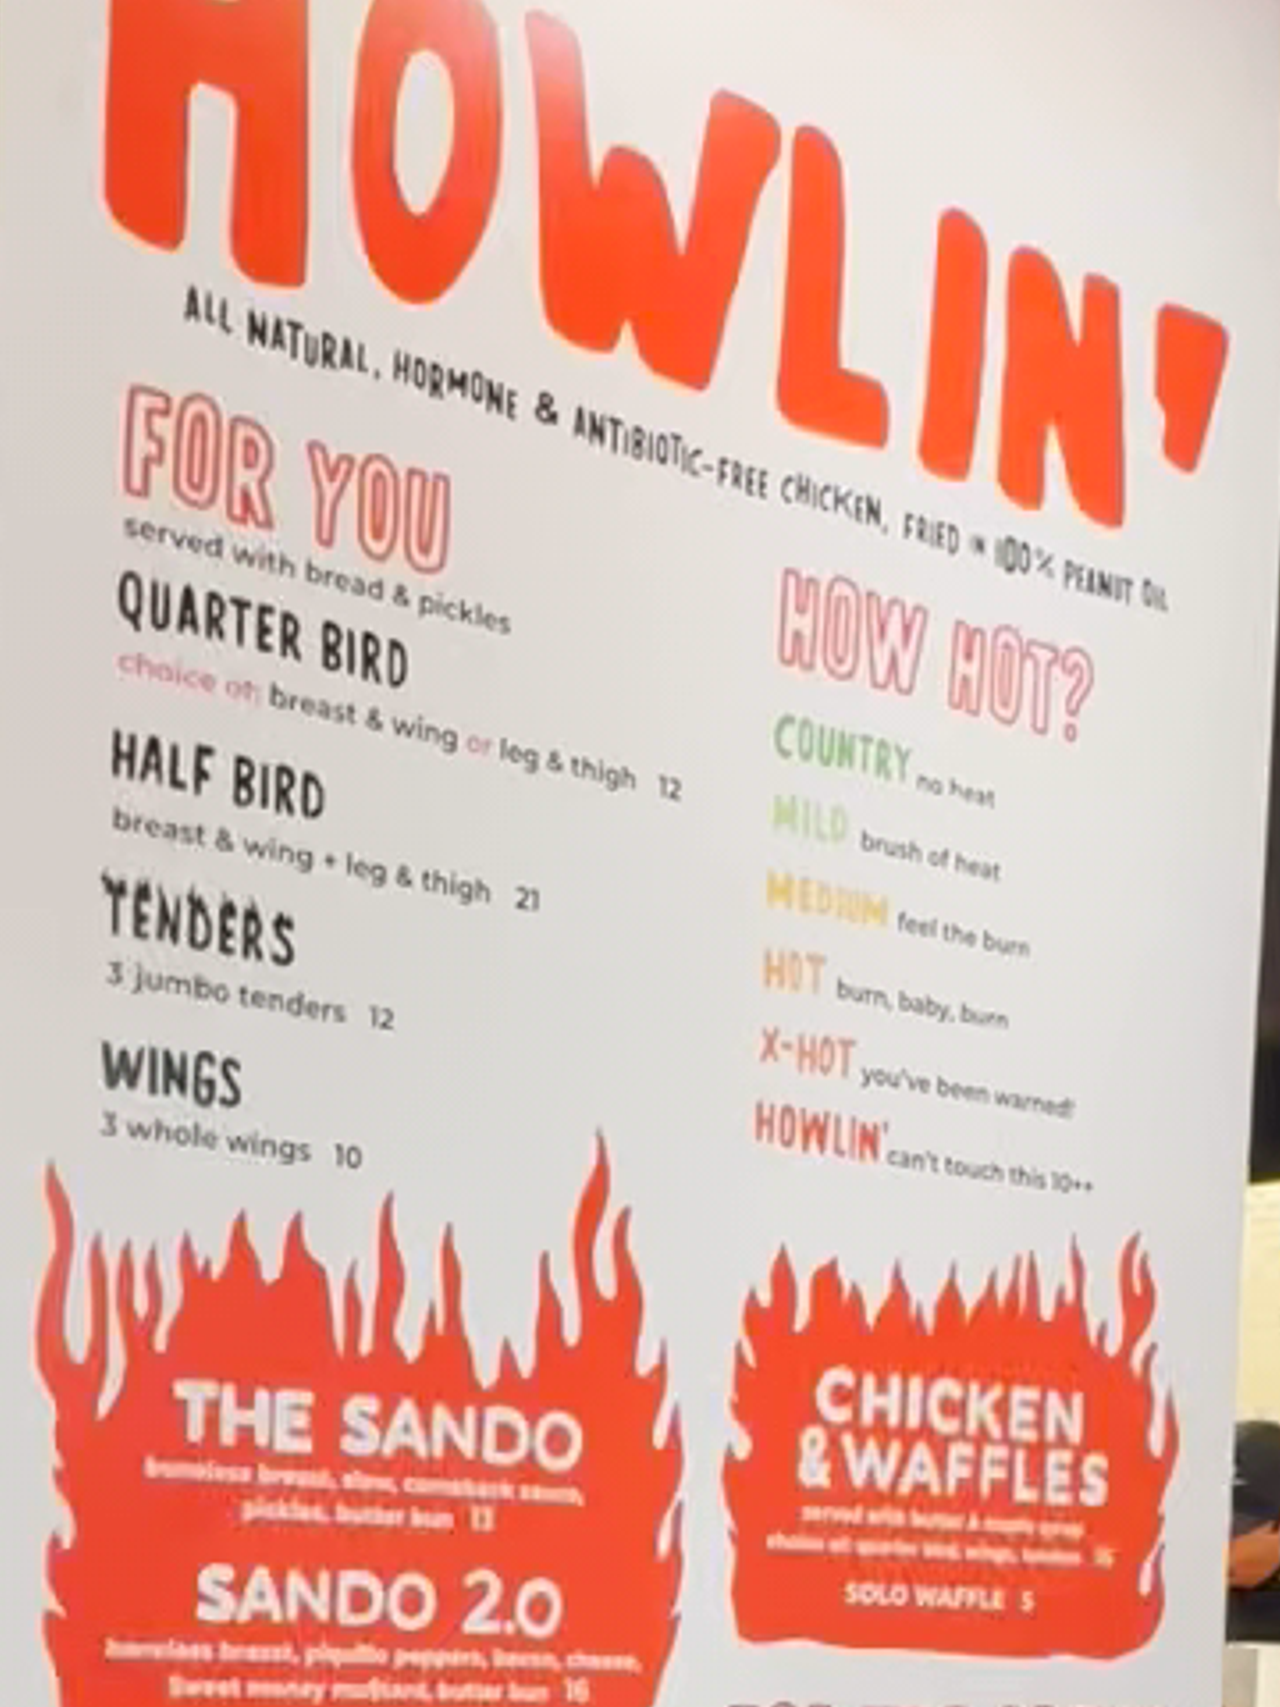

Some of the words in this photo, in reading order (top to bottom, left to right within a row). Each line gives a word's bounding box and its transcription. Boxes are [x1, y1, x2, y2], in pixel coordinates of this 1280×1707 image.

[123, 384, 274, 530] FOR
[307, 440, 451, 576] YOU
[183, 286, 232, 334] ALL
[248, 310, 381, 381] NATURAL,
[393, 350, 518, 421] HORMONE
[535, 393, 558, 426] &
[573, 407, 768, 498] ANTIBIOTIC-FREE
[780, 473, 888, 535] CHICKEN,
[904, 513, 958, 556] FRIED
[994, 536, 1052, 577] 100%
[1063, 559, 1135, 605] PEANUT
[123, 515, 223, 559] served
[233, 538, 295, 580] with
[305, 555, 384, 601] bread
[393, 583, 410, 608] &
[419, 591, 513, 635] pickles
[118, 569, 303, 661] QUARTER
[321, 620, 409, 688] BIRD
[777, 566, 928, 696] HOW
[948, 619, 1094, 742] HOT?
[117, 652, 216, 693] choice
[269, 682, 356, 726] breast
[366, 707, 383, 731] &
[393, 714, 458, 753] wing
[467, 733, 491, 755] or
[499, 737, 539, 773] leg
[546, 747, 564, 772] &
[571, 754, 637, 791] thigh
[658, 774, 682, 800] 12
[773, 714, 913, 782] COUNTRY
[916, 774, 943, 796] no
[950, 777, 995, 808] heat
[111, 729, 215, 796] HALF
[233, 756, 326, 820] BIRD
[112, 805, 205, 848] breast
[216, 828, 234, 852] &
[244, 833, 314, 873] wing
[346, 853, 387, 889] leg
[396, 864, 413, 888] &
[421, 869, 491, 904] thigh
[515, 886, 540, 911] 21
[772, 794, 848, 844] MILD
[860, 830, 922, 863] brush
[928, 847, 949, 868] of
[954, 851, 1001, 883] heat
[100, 870, 297, 968] TENDERS
[765, 868, 889, 926] MEDIUM
[897, 910, 937, 938] feel
[943, 920, 977, 948] the
[983, 929, 1031, 957] burn
[106, 960, 125, 987] 3
[132, 963, 230, 1006] jumbo
[238, 983, 347, 1024] tenders
[368, 1005, 395, 1030] 12
[763, 947, 827, 994] HOT
[836, 977, 892, 1011] burn,
[898, 990, 955, 1024] baby,
[961, 1002, 1009, 1029] burn
[101, 1039, 242, 1109] WINGS
[760, 1026, 857, 1078] X-HOT
[860, 1065, 930, 1095] you've
[937, 1076, 990, 1105] been
[994, 1088, 1076, 1119] warned!
[100, 1112, 118, 1138] 3
[127, 1117, 218, 1151] whole
[226, 1128, 312, 1165] wings
[334, 1142, 363, 1170] 10
[755, 1101, 890, 1163] HOWLIN'
[887, 1148, 939, 1174] can't
[944, 1155, 1004, 1184] touch
[1009, 1165, 1047, 1191] this
[172, 1379, 314, 1455] THE
[340, 1393, 584, 1473] SANDO
[815, 1365, 1084, 1445] CHICKEN
[196, 1562, 437, 1632] SANDO
[462, 1568, 564, 1641] 2.0
[844, 1582, 909, 1606] SOLO
[914, 1584, 1004, 1611] WAFFLE
